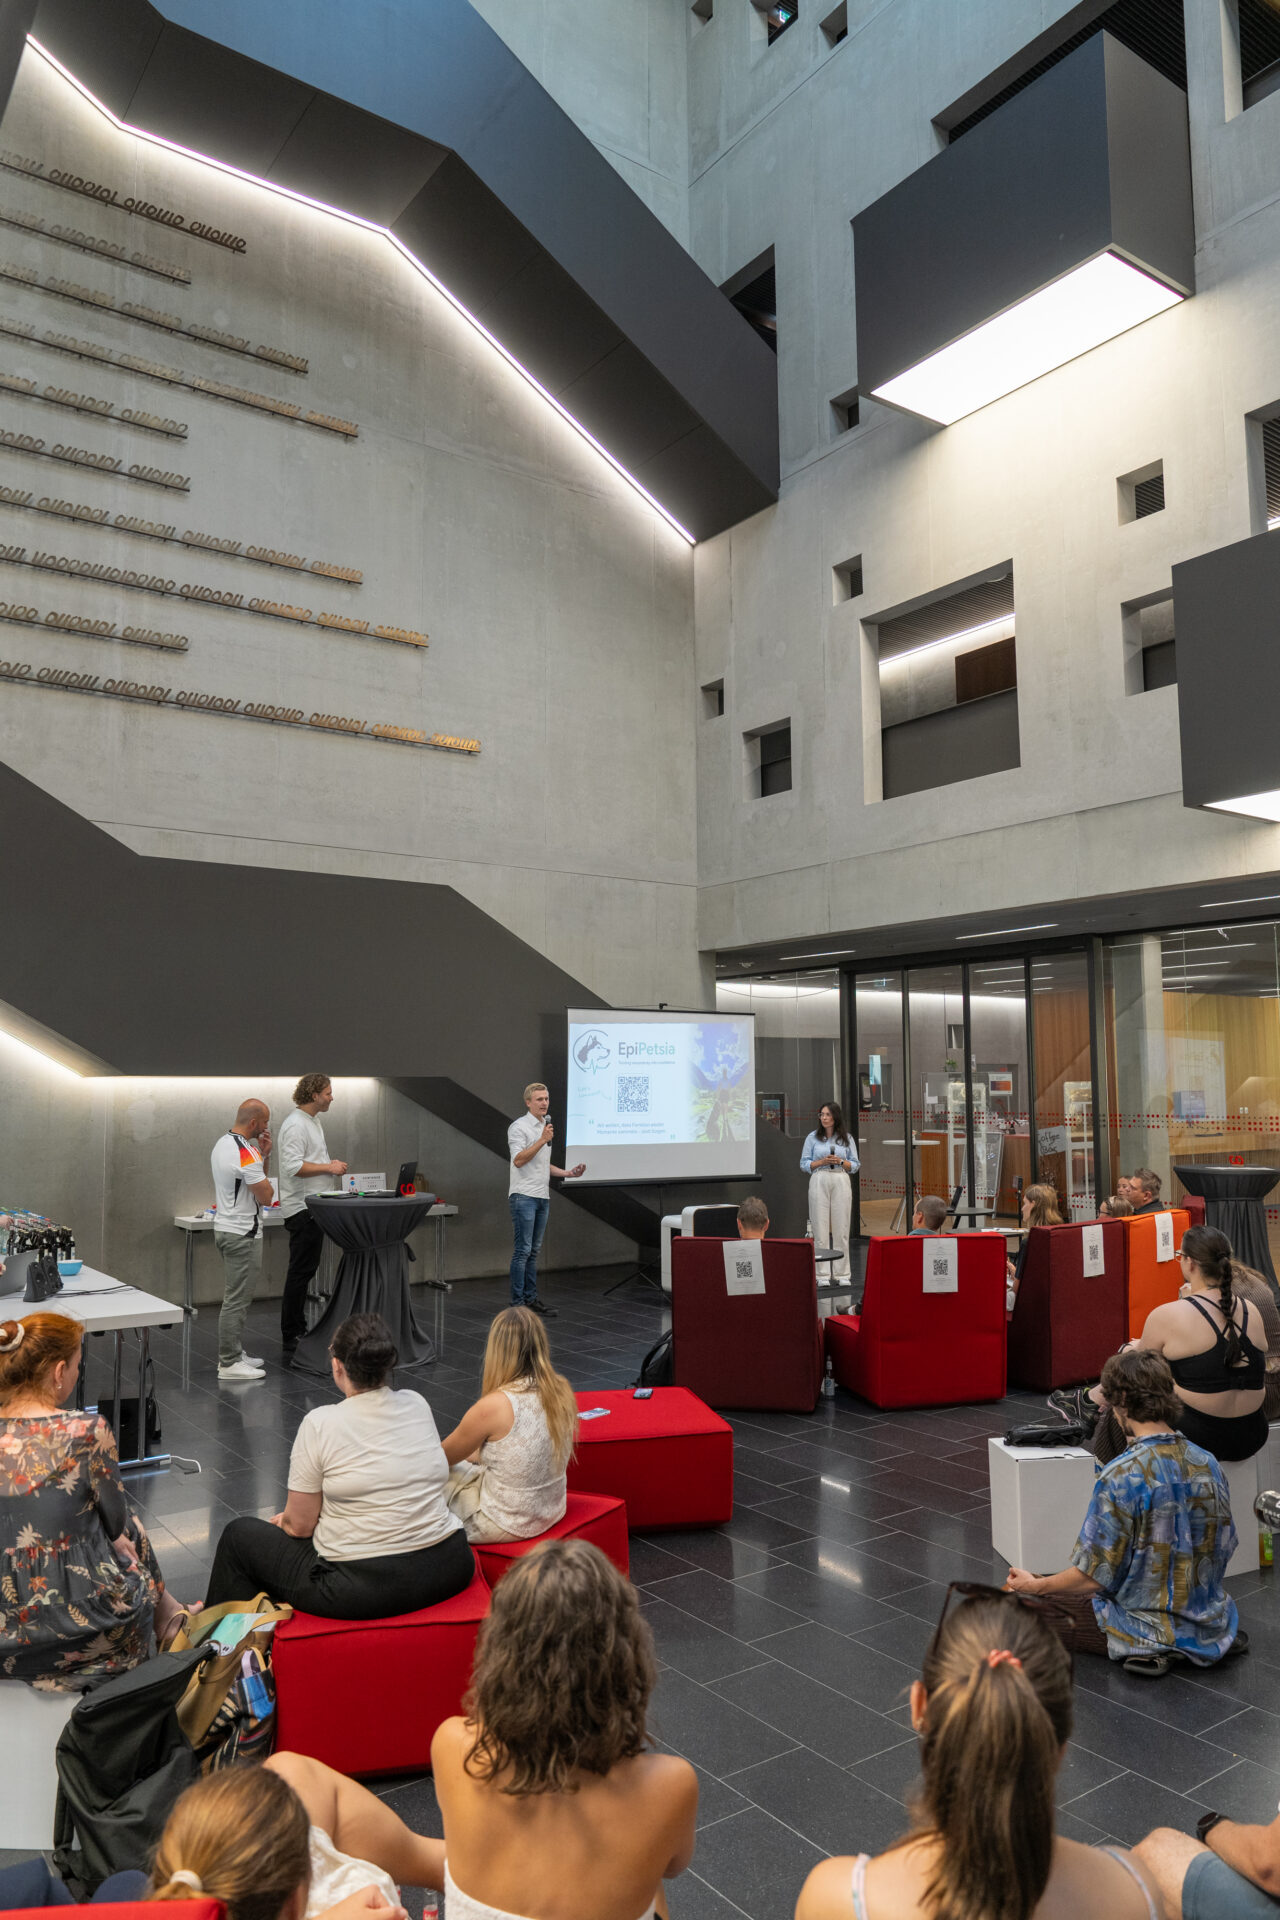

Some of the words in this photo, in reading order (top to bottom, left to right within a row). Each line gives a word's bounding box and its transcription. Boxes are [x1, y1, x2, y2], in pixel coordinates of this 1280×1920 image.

[51, 442, 122, 469] 01100101
[179, 582, 243, 604] 01100011
[44, 610, 116, 632] 01100101
[121, 624, 188, 645] 01110010
[36, 667, 99, 687] 01110111
[102, 677, 172, 698] 01100101
[175, 689, 240, 709] 01101001
[243, 700, 304, 720] 01100110
[618, 1041, 675, 1058] EpiPetsia
